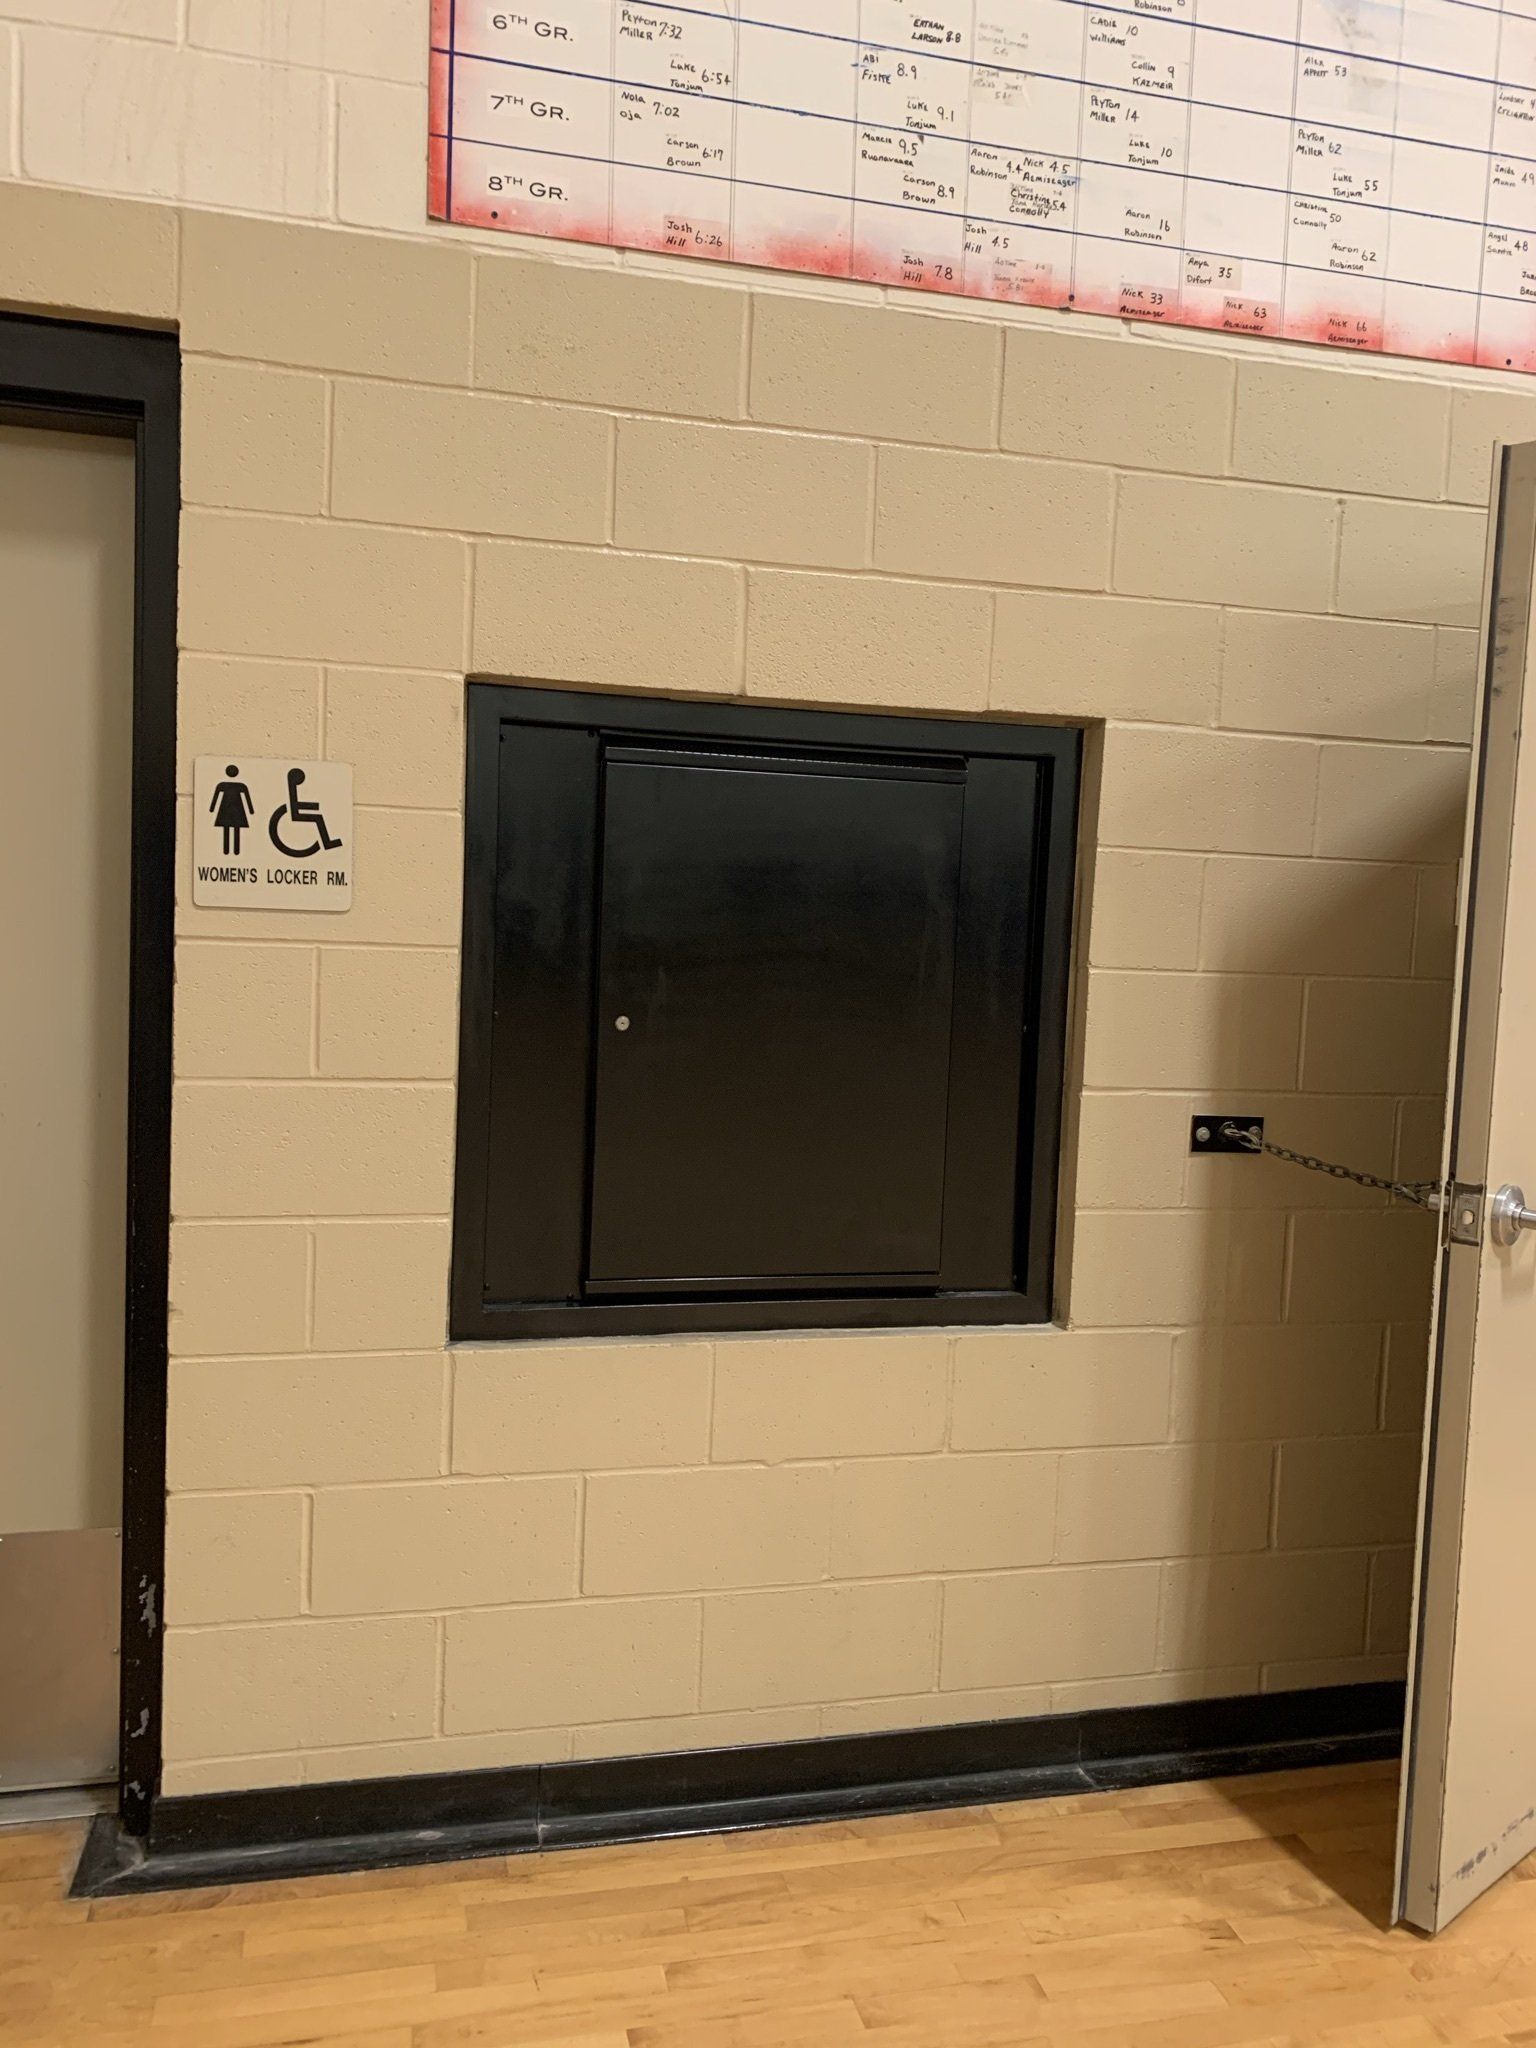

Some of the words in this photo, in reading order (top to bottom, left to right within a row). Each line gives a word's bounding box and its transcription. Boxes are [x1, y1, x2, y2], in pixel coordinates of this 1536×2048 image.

[492, 14, 528, 31] 6TH
[534, 21, 574, 41] GR.
[658, 21, 683, 39] 7:32
[1125, 24, 1139, 37] 10
[911, 32, 944, 44] LARSON
[701, 69, 731, 86] 6:54
[896, 62, 918, 80] 8.9
[1167, 65, 1176, 79] 9
[1334, 65, 1347, 77] 53
[490, 94, 525, 110] 7TH
[530, 101, 570, 121] GR.
[621, 91, 647, 104] Nola
[652, 102, 680, 118] 7:02
[936, 105, 955, 122] 9.1
[1125, 108, 1140, 122] 14
[666, 138, 699, 149] Carson
[702, 147, 724, 161] 6:17
[898, 138, 919, 157] 9.5
[970, 148, 998, 160] Aaron
[1160, 146, 1173, 158] 10
[1328, 142, 1342, 155] 62
[666, 156, 701, 167] Brown
[1022, 156, 1044, 168] Nick
[969, 164, 1008, 181] Robinson
[1520, 172, 1535, 185] 49
[488, 175, 523, 191] 8TH
[529, 182, 569, 201] GR.
[902, 174, 936, 187] Carson
[936, 184, 955, 199] 8.9
[1363, 179, 1379, 192] 55
[902, 190, 936, 205] Brown
[1125, 208, 1151, 220] Aaron
[1159, 218, 1171, 232] 16
[1329, 213, 1342, 223] 50
[667, 220, 693, 233] Josh
[694, 230, 723, 247] 6:26
[965, 223, 987, 235] Josh
[1124, 227, 1163, 241] Robinson
[665, 235, 686, 248] Hill
[963, 241, 982, 254] Hill
[991, 235, 1010, 249] 4.5
[1514, 240, 1529, 252] 48
[1331, 242, 1359, 254] Aaron
[1360, 251, 1377, 263] 62
[903, 255, 924, 267] Josh
[902, 270, 923, 284] Hill
[1217, 266, 1233, 279] 35
[1121, 288, 1144, 299] Nick
[1149, 292, 1164, 305] 33
[1225, 300, 1244, 311] Nick
[1253, 306, 1268, 319] 63
[1328, 318, 1349, 328] Nick
[1356, 321, 1368, 332] 66
[197, 866, 258, 884] WOMEN'S
[267, 868, 318, 885] LOCKER
[326, 871, 348, 886] RM.
